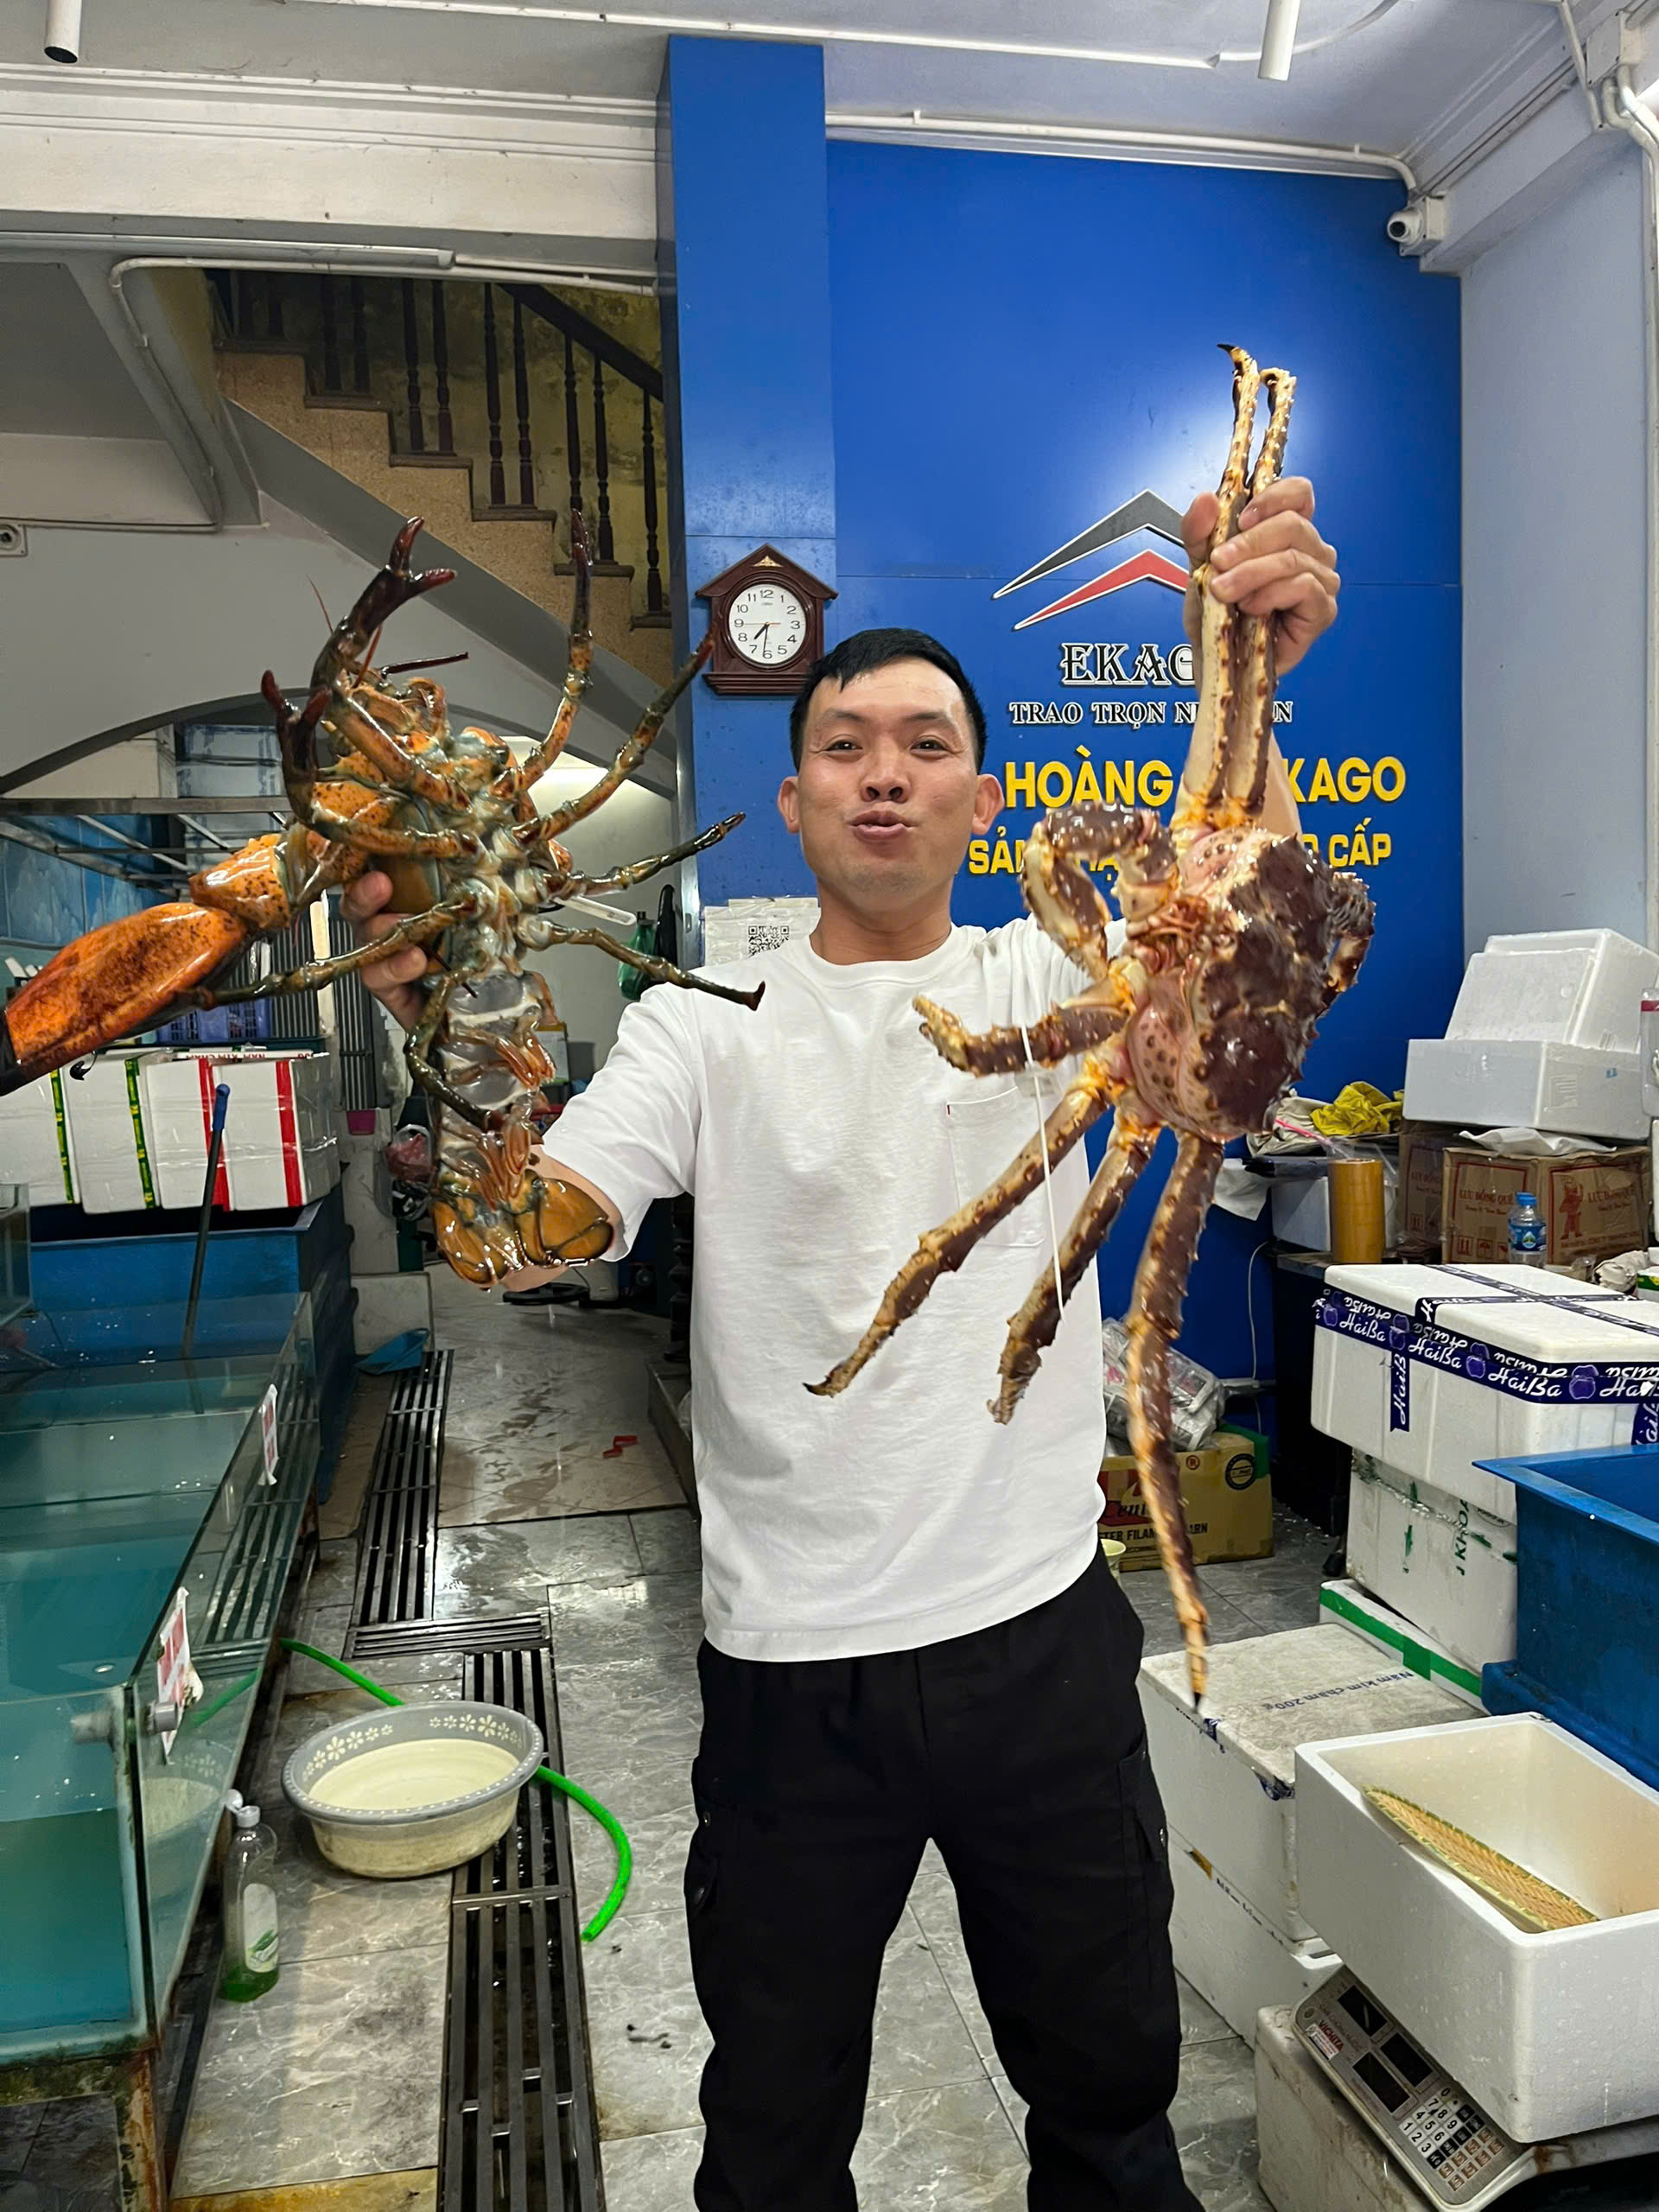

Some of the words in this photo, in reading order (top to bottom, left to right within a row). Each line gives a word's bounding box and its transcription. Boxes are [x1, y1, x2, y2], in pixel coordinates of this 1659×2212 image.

[747, 594, 757, 602] 11
[760, 589, 774, 599] 12
[737, 604, 748, 613] 10
[786, 606, 797, 614] 2
[734, 619, 744, 628] 9
[791, 620, 801, 630] 3
[738, 632, 747, 642] 8
[787, 634, 797, 643] 4
[749, 645, 758, 654] 7
[777, 645, 787, 655] 5
[763, 650, 772, 659] 6
[1008, 702, 1084, 724] TRAO
[1091, 701, 1166, 729] TRỌN
[1005, 745, 1173, 808] HOÀNG
[1328, 817, 1392, 868] CẤP
[1339, 1313, 1386, 1342] HaiBa
[1408, 1338, 1462, 1369] HaiBa
[1488, 1368, 1562, 1397] HaiBa
[1441, 2088, 1451, 2097] 0
[1428, 2098, 1439, 2107] 7
[1416, 2111, 1426, 2120] 4
[1438, 2109, 1448, 2119] 8
[1403, 2122, 1414, 2131] 1
[1425, 2121, 1436, 2130] 5
[1447, 2120, 1458, 2129] 9
[1411, 2133, 1422, 2142] 2
[1434, 2132, 1445, 2141] 6
[1421, 2143, 1432, 2152] 3
